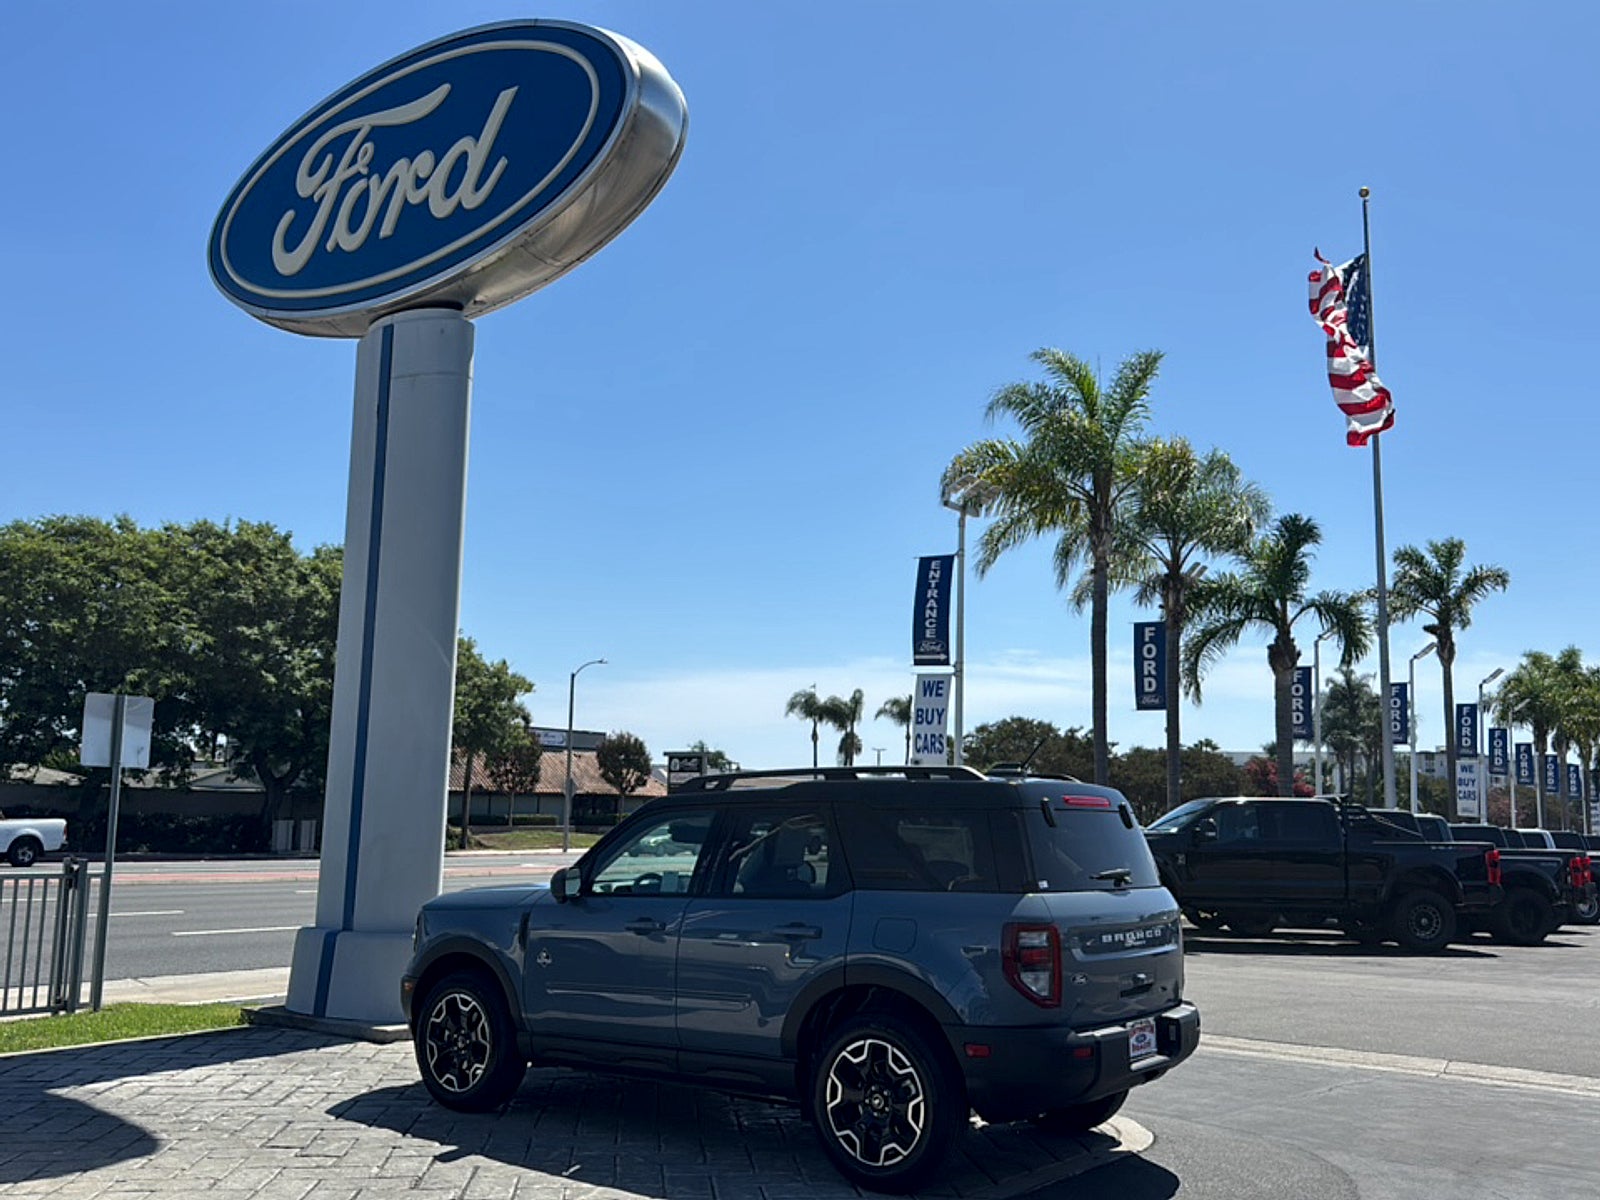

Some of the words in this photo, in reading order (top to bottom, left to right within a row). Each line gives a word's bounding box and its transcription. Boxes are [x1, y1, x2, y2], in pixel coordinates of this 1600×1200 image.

[272, 83, 519, 276] Ford
[924, 560, 942, 639] ENTRANCE
[1142, 626, 1157, 693] FORD
[922, 680, 945, 698] WE
[1291, 670, 1304, 725] FORD
[915, 708, 945, 725] BUY
[1390, 686, 1401, 732] FORD
[1461, 706, 1472, 747] FORD
[915, 735, 945, 754] CARS
[1493, 731, 1503, 766] FORD
[1460, 764, 1474, 773] WE
[1519, 745, 1529, 777] FORD
[1458, 778, 1476, 788] BUY
[1458, 790, 1476, 801] CARS
[1101, 929, 1162, 943] BRONCO
